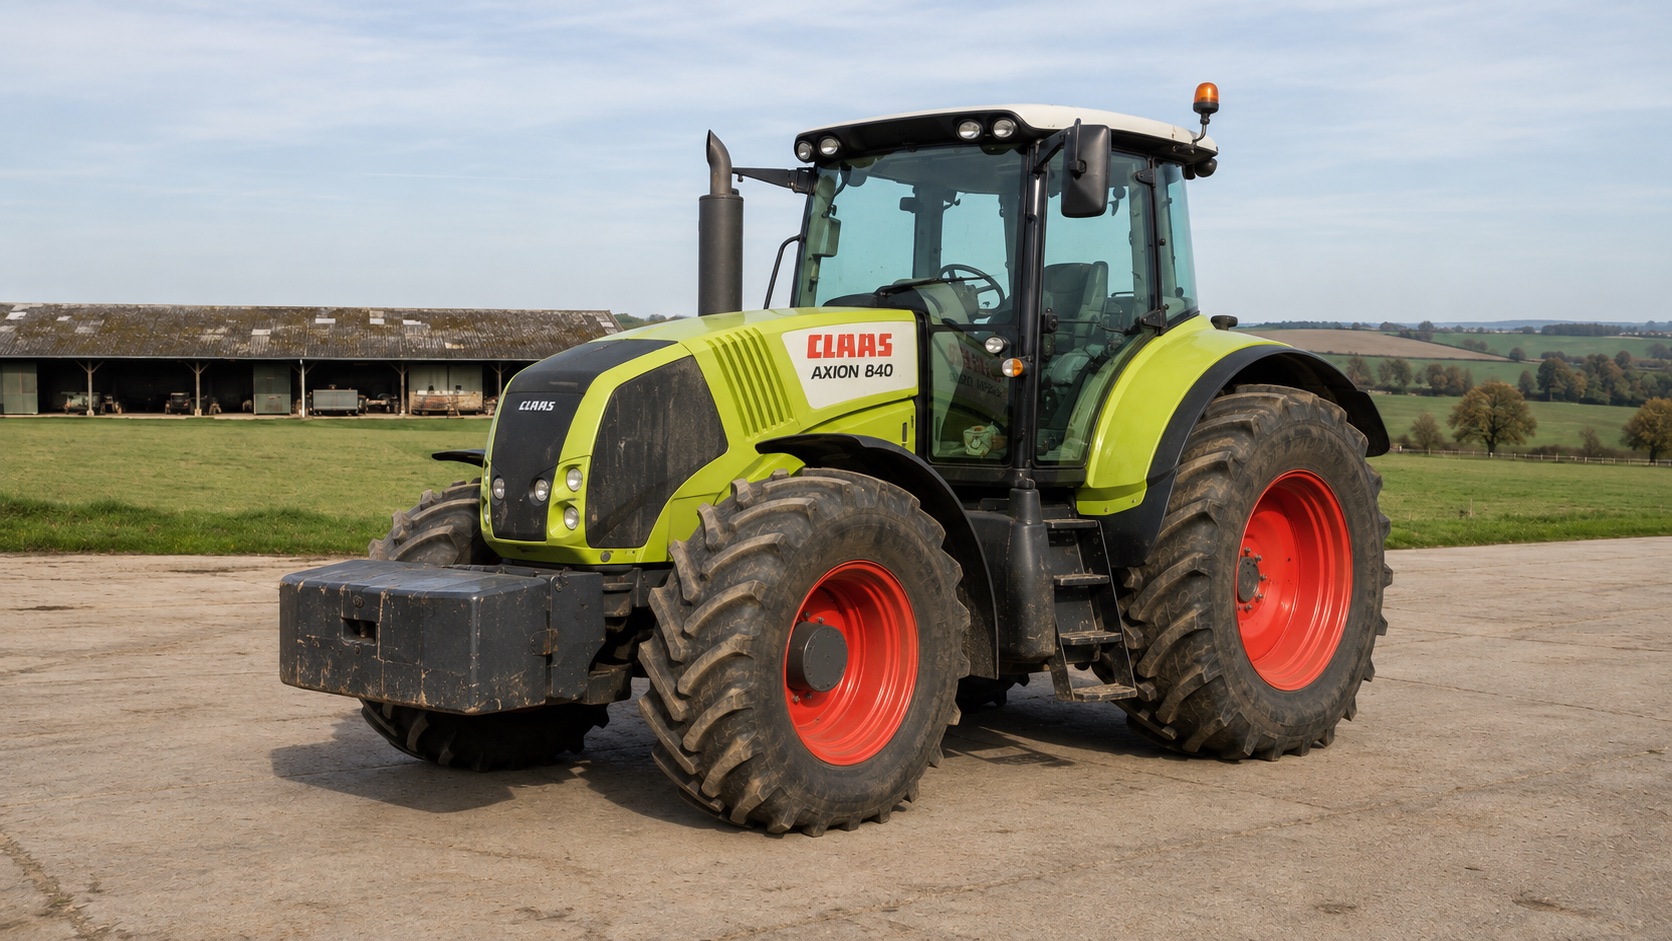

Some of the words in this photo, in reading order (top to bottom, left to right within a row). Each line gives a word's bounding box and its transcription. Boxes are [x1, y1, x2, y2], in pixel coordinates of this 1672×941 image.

[807, 333, 892, 358] CLAAS
[811, 364, 859, 379] AXION
[864, 363, 893, 378] 840
[518, 400, 556, 411] CLAAS
